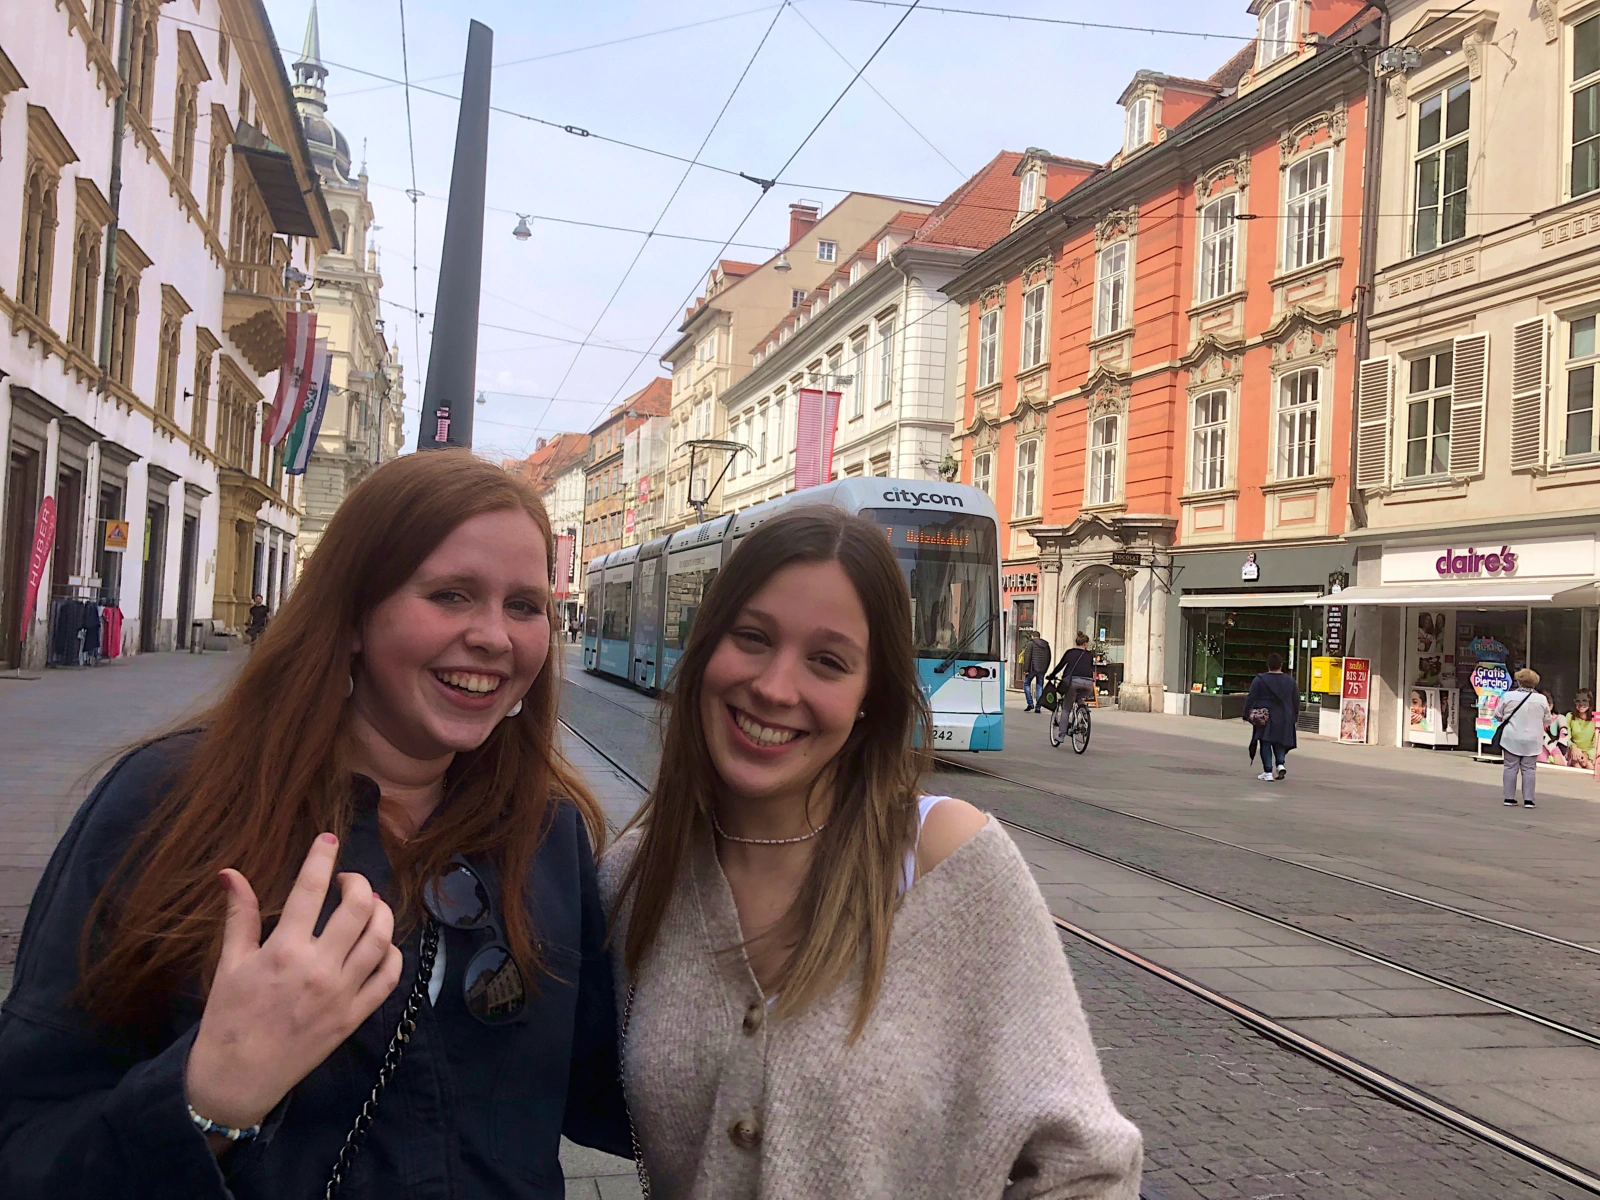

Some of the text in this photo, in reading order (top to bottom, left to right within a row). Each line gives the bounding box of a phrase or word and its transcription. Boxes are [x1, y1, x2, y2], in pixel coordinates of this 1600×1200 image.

[883, 487, 963, 507] citycom
[30, 508, 50, 587] HUBER
[1435, 545, 1516, 575] claire's
[1358, 671, 1367, 681] ZU
[1477, 667, 1505, 678] Gratis
[1475, 676, 1508, 690] Piercing
